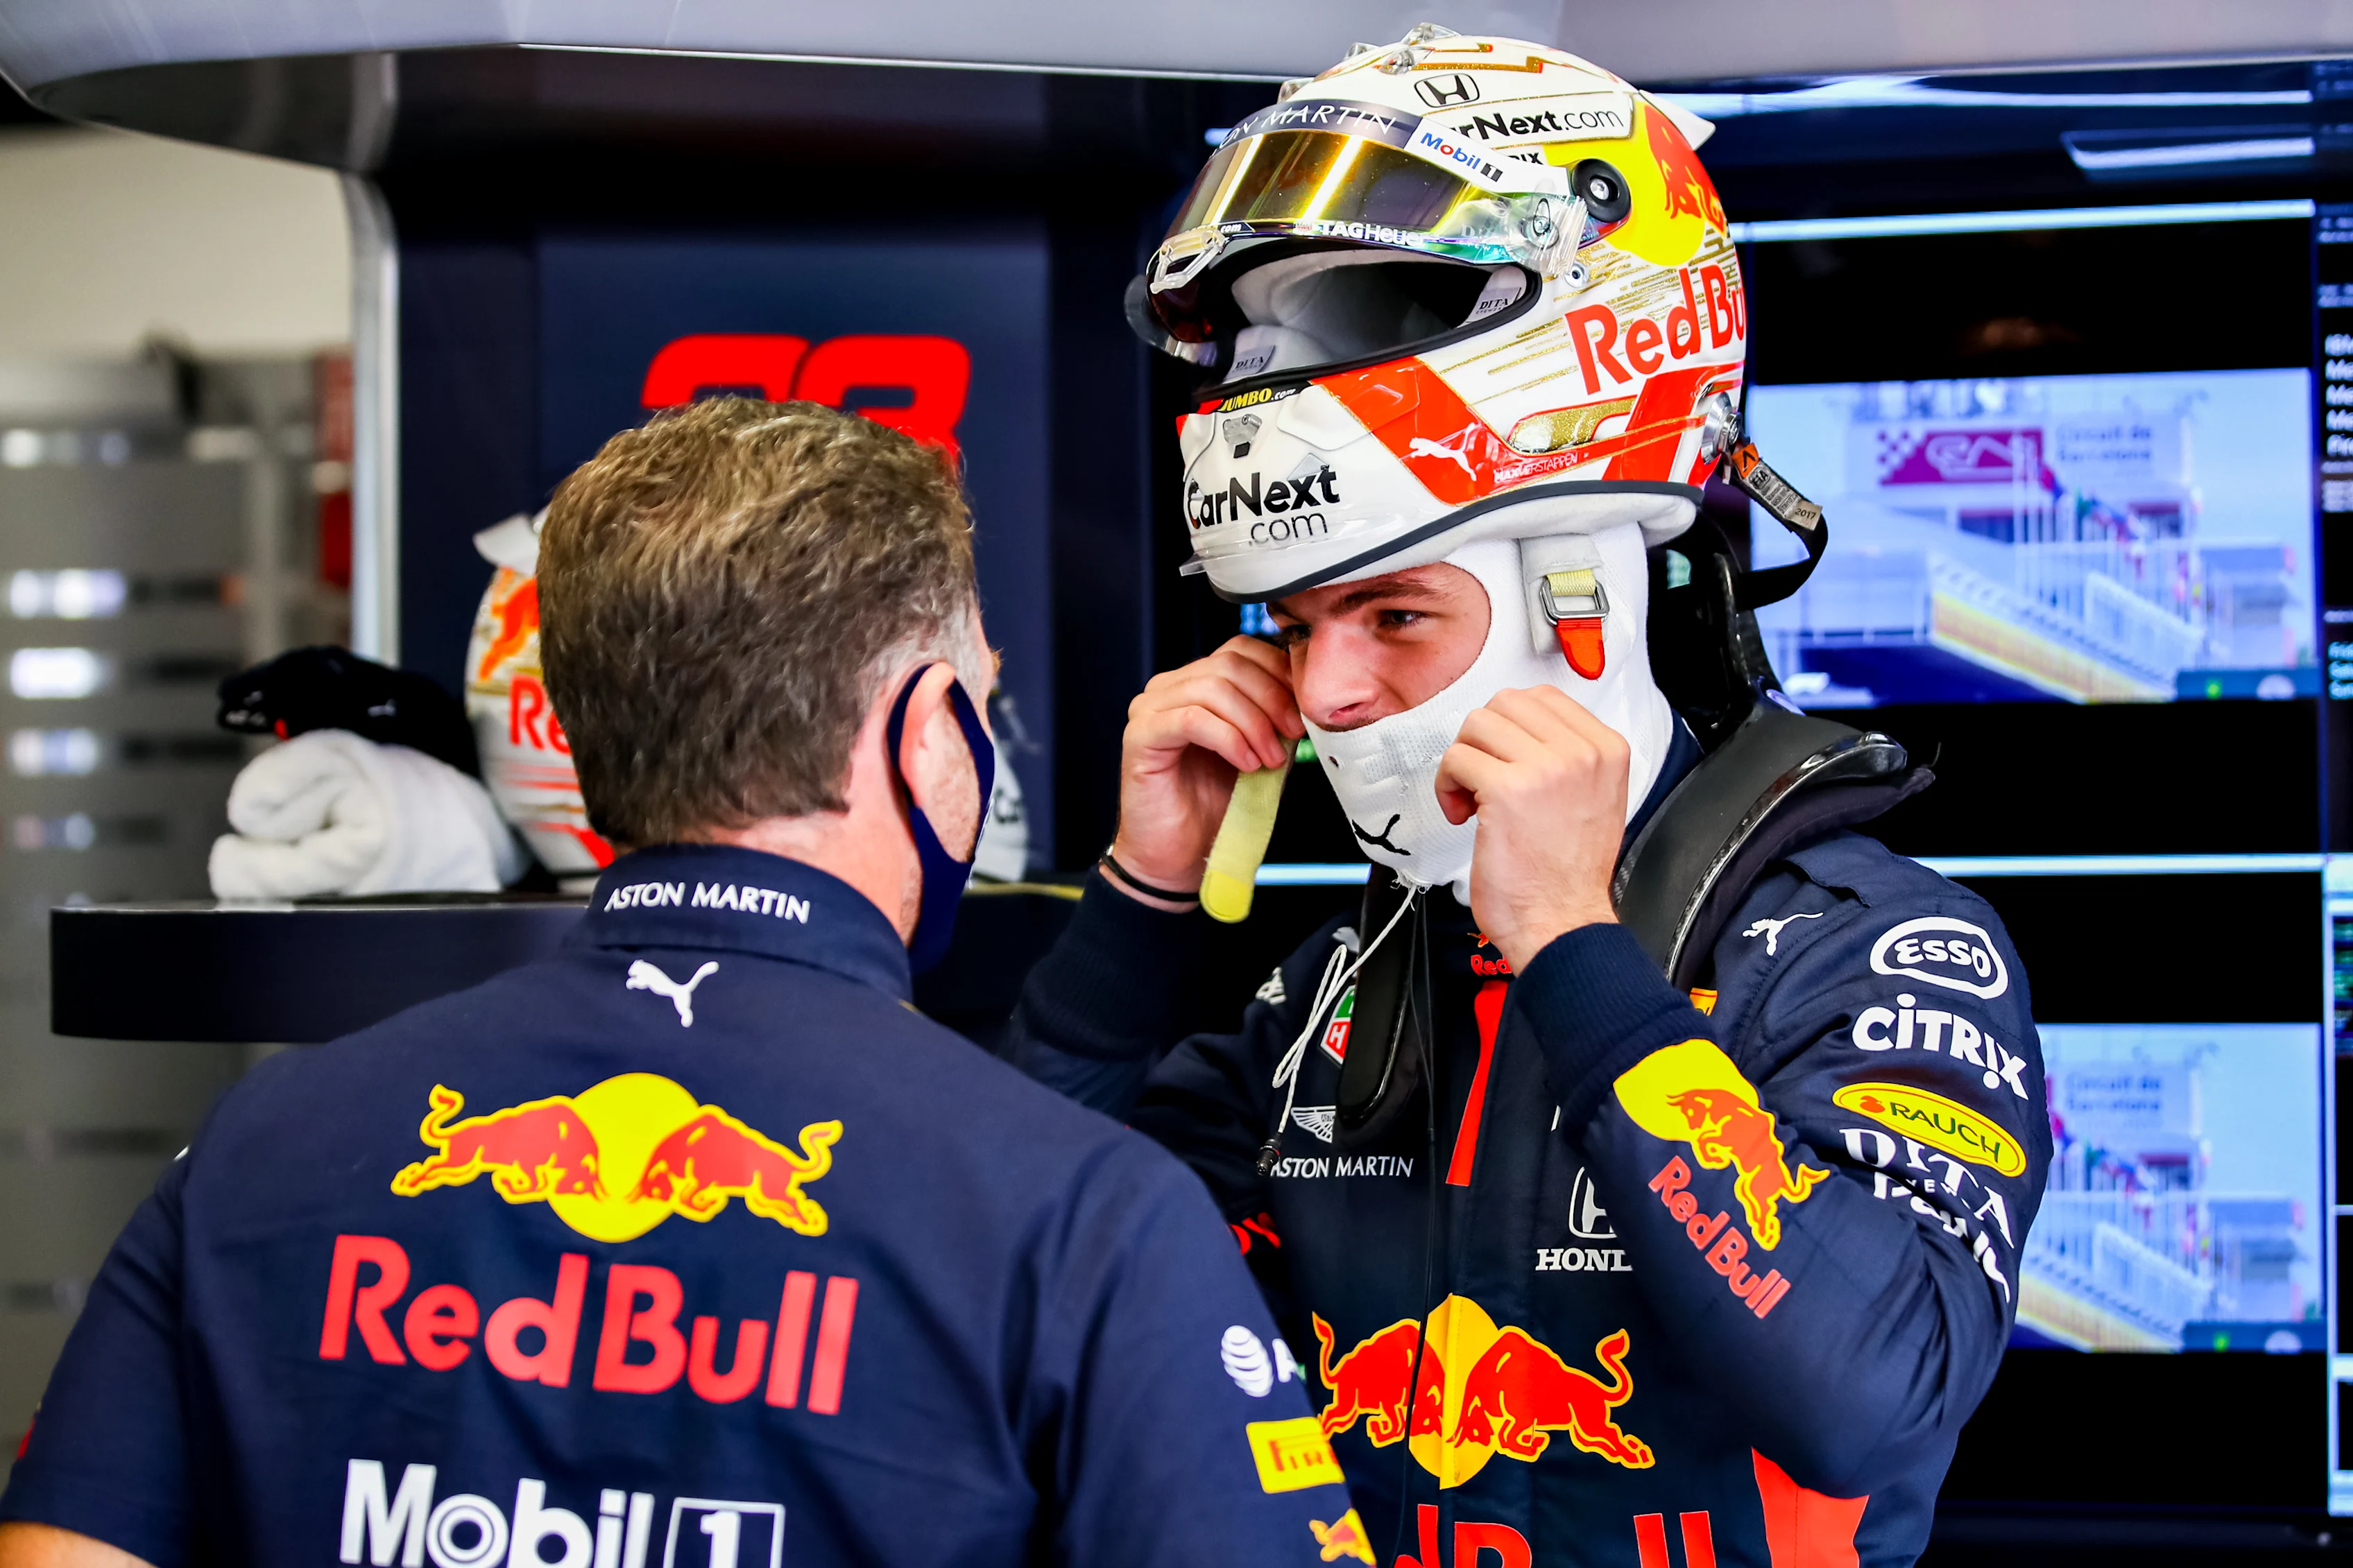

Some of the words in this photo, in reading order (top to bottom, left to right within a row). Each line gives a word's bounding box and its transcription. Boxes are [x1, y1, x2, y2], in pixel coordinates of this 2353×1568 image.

[1260, 105, 1396, 135] MARTIN
[1420, 132, 1481, 169] Mobil
[1478, 298, 1508, 310] DITA
[1564, 268, 1701, 395] Red
[1699, 264, 1747, 349] Bu
[1235, 356, 1264, 370] DITA
[1188, 465, 1340, 529] CarNext
[1795, 508, 1817, 520] 2017
[603, 881, 685, 913] ASTON
[690, 881, 811, 924] MARTIN
[1890, 1101, 2001, 1164] RAUCH
[1270, 1157, 1330, 1178] ASTON
[1335, 1156, 1414, 1178] MARTIN
[1839, 1128, 2014, 1249] DITA
[1648, 1155, 1731, 1250] Red
[1704, 1226, 1791, 1319] Bull
[1535, 1248, 1633, 1272] HON
[319, 1234, 589, 1388] Red
[592, 1263, 859, 1415] Bull
[339, 1458, 655, 1568] Mobil
